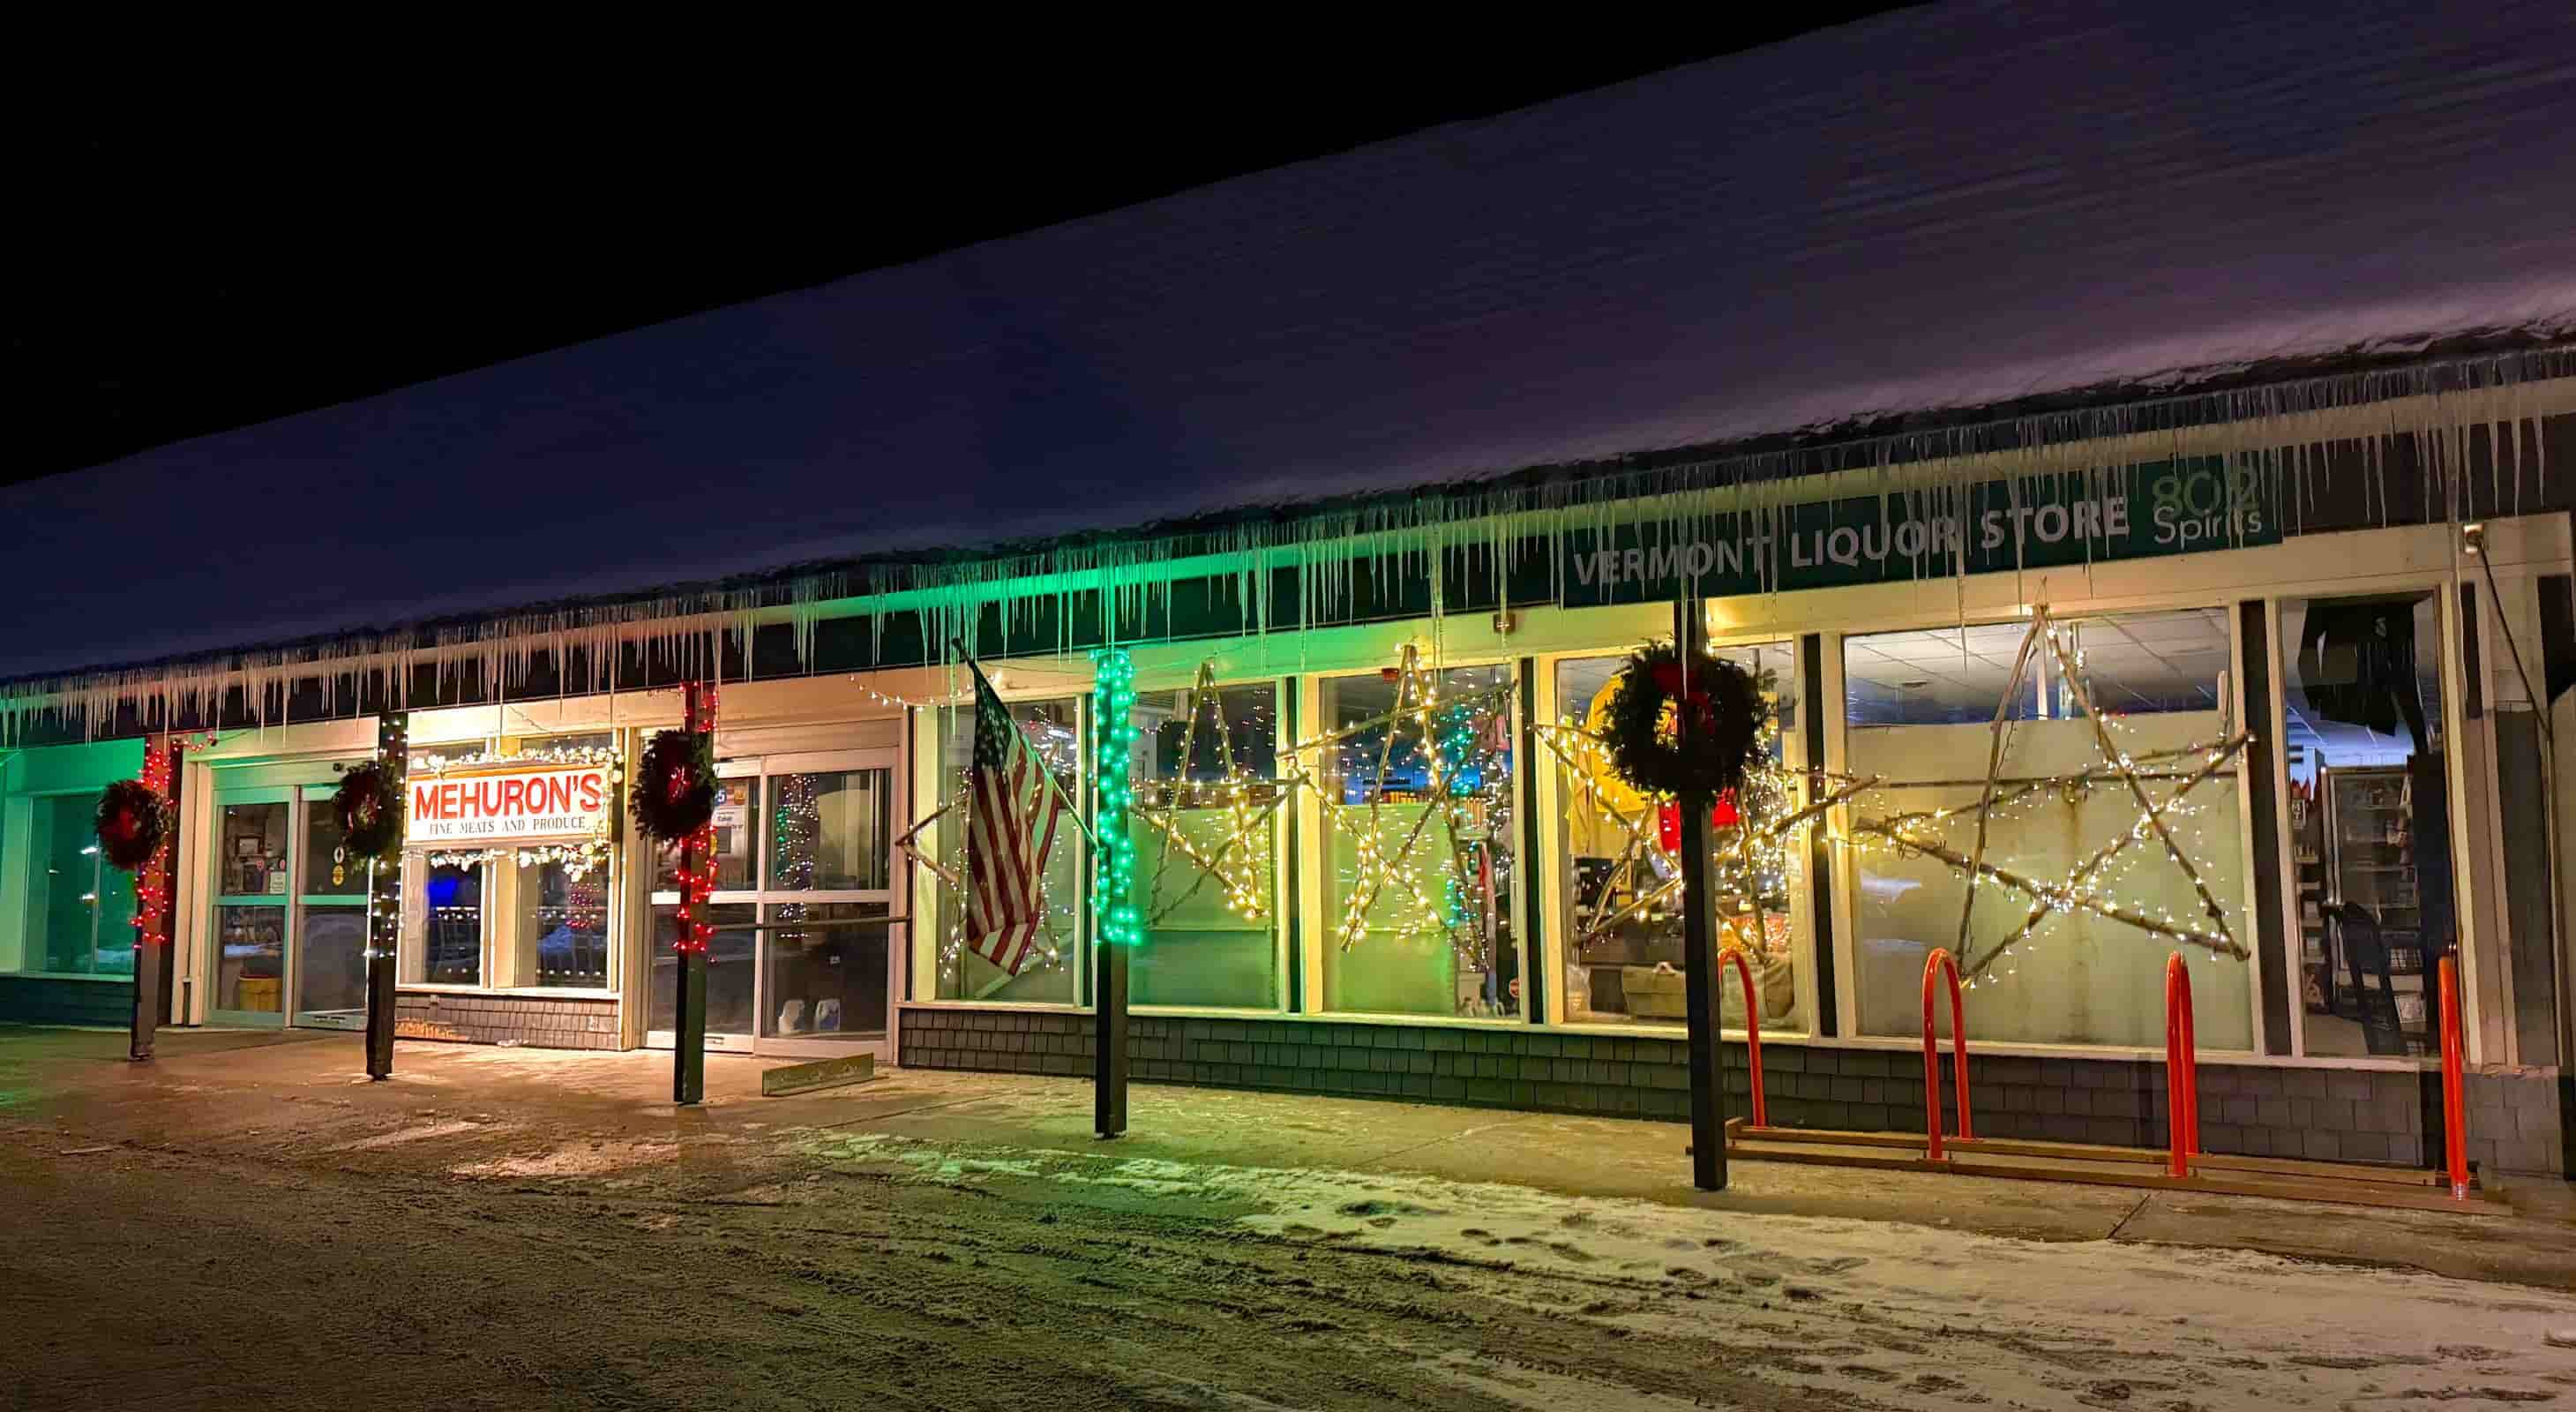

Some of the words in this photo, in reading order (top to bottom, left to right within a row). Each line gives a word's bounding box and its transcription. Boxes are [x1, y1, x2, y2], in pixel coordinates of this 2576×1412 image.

[1574, 535, 1775, 586] VERMONT
[1791, 516, 1960, 567] LIQUOR
[1980, 494, 2130, 551] STORE
[2153, 507, 2263, 551] Spirits
[415, 772, 603, 821] MEHURON'S
[430, 822, 453, 835] FINE
[459, 820, 496, 834] MEATS
[502, 819, 526, 832] AND
[533, 815, 586, 831] PRODUCE
